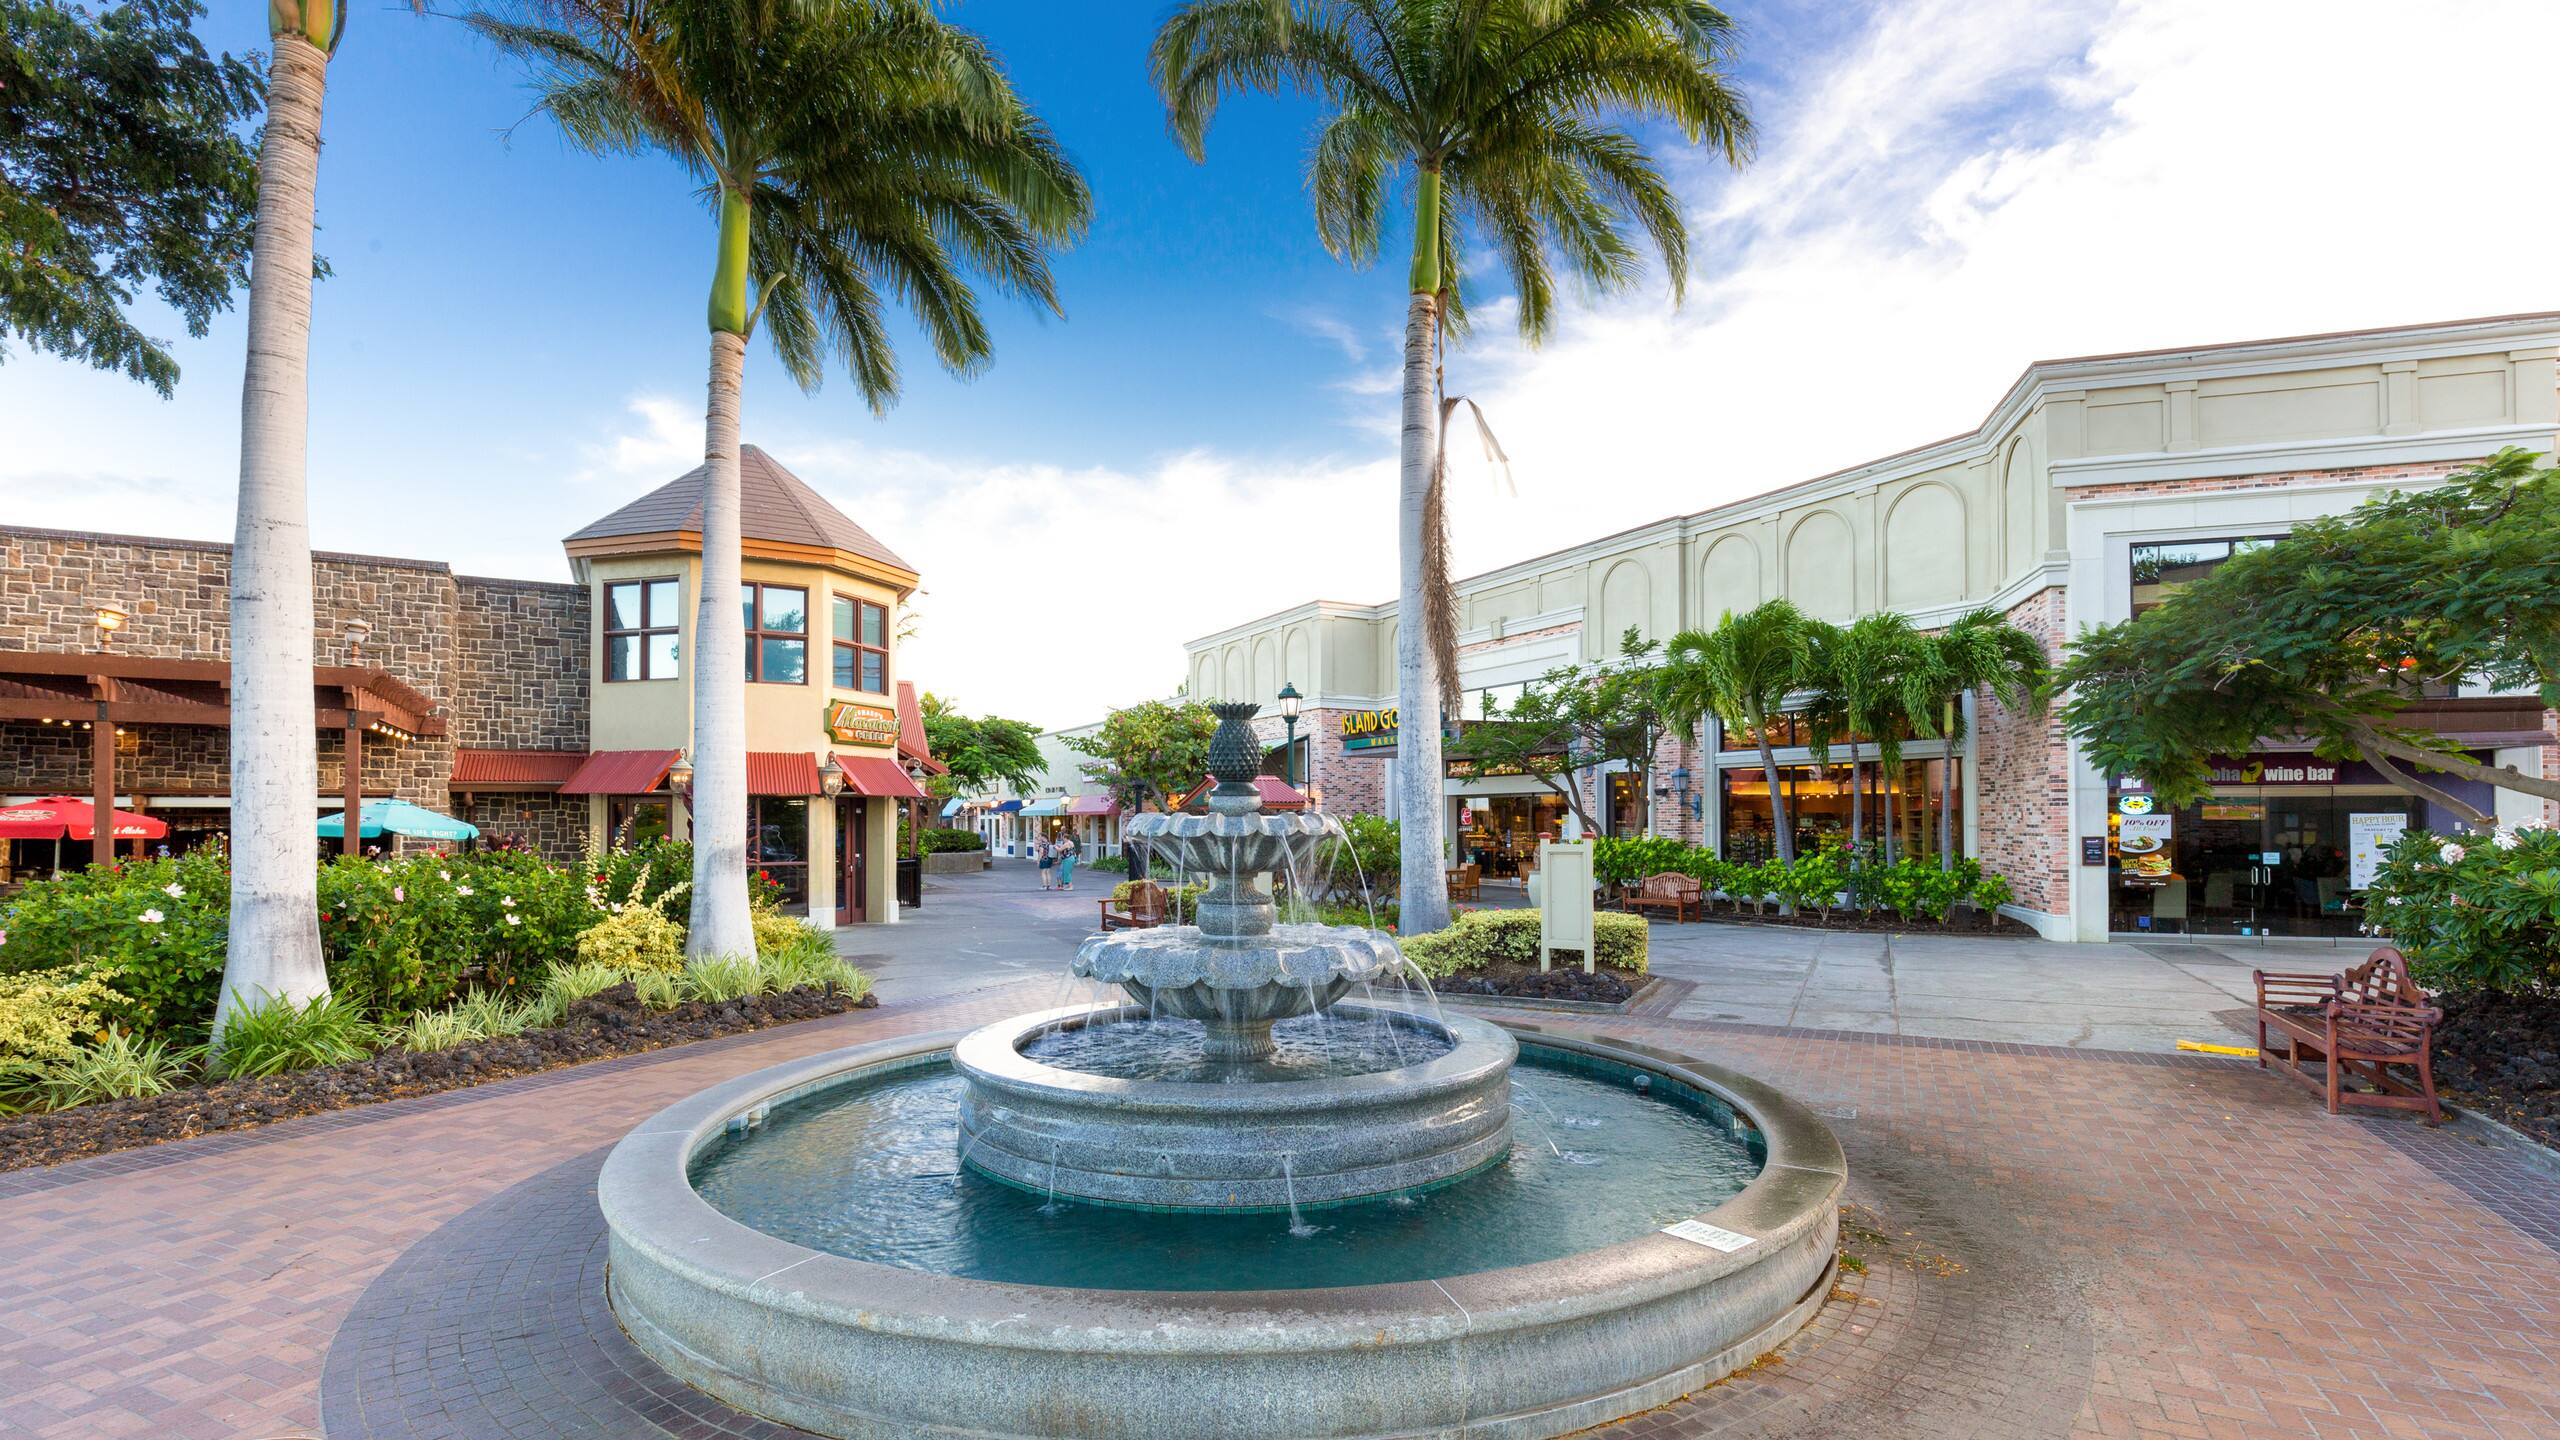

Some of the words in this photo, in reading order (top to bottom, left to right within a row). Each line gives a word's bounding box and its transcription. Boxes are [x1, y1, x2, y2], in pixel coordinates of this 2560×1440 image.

[1341, 710, 1378, 735] ISLAND
[1370, 736, 1398, 747] MARK
[2200, 766, 2241, 782] oha
[2264, 766, 2304, 782] wine
[2307, 766, 2336, 782] bar
[2352, 816, 2380, 825] HAPPY
